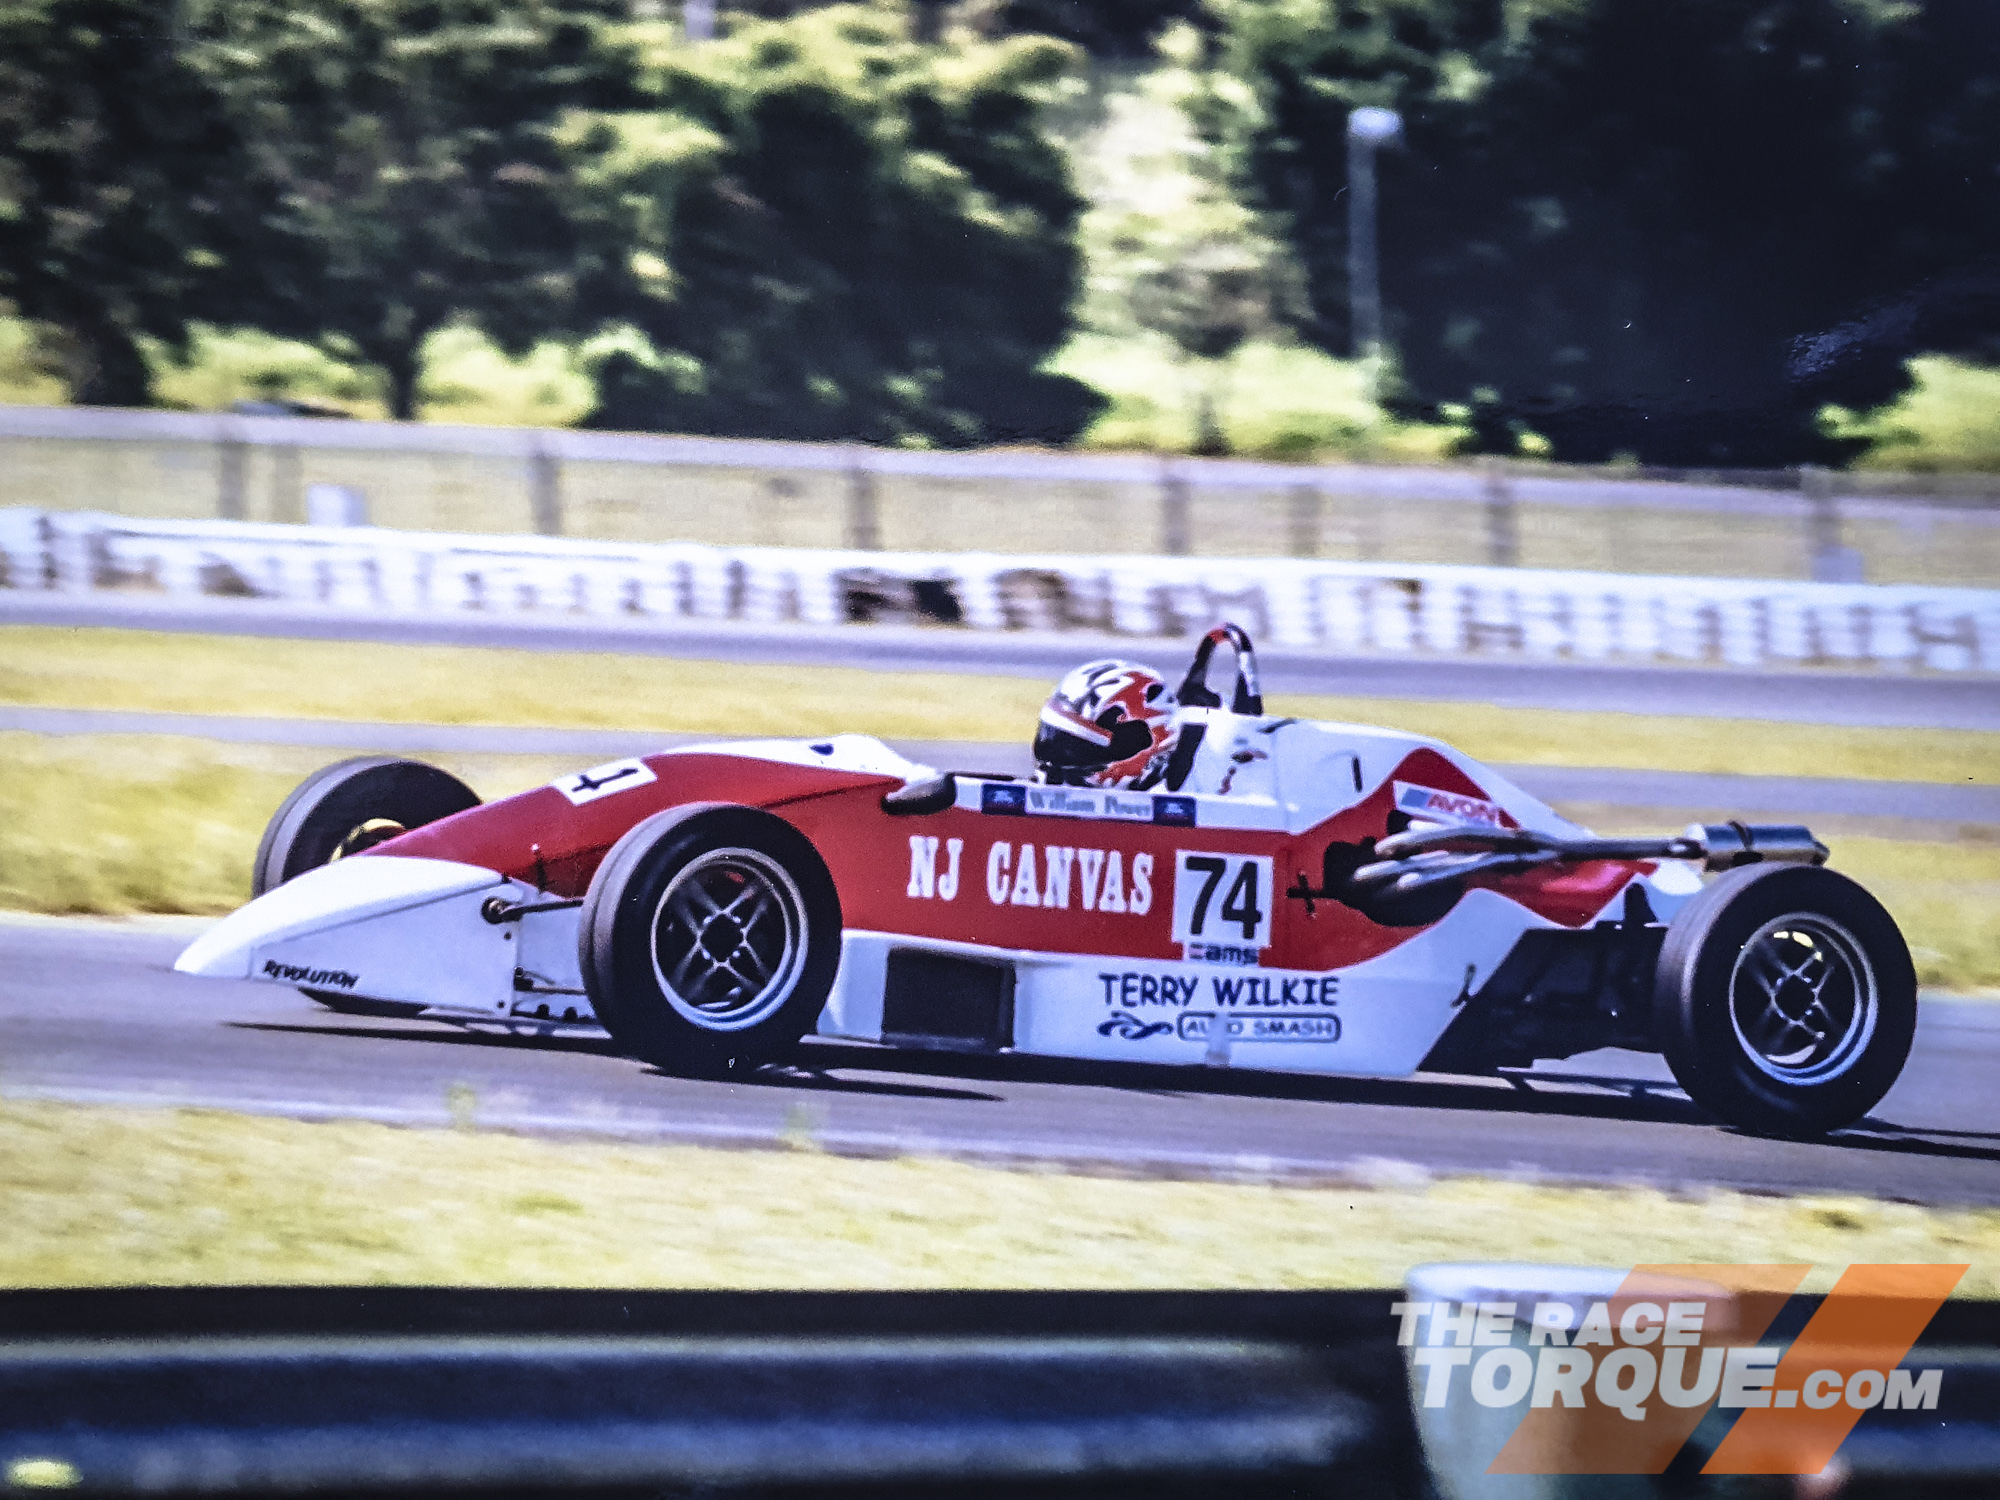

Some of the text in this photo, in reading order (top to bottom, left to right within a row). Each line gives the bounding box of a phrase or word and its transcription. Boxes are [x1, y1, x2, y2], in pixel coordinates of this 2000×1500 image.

[1427, 793, 1499, 822] AVON
[906, 835, 1154, 916] NJ CANVAS
[1184, 855, 1263, 940] 74
[263, 959, 360, 989] REVOLUTION
[1098, 972, 1340, 1008] TERRY WILKIE
[1186, 1019, 1333, 1036] AUO SMASH
